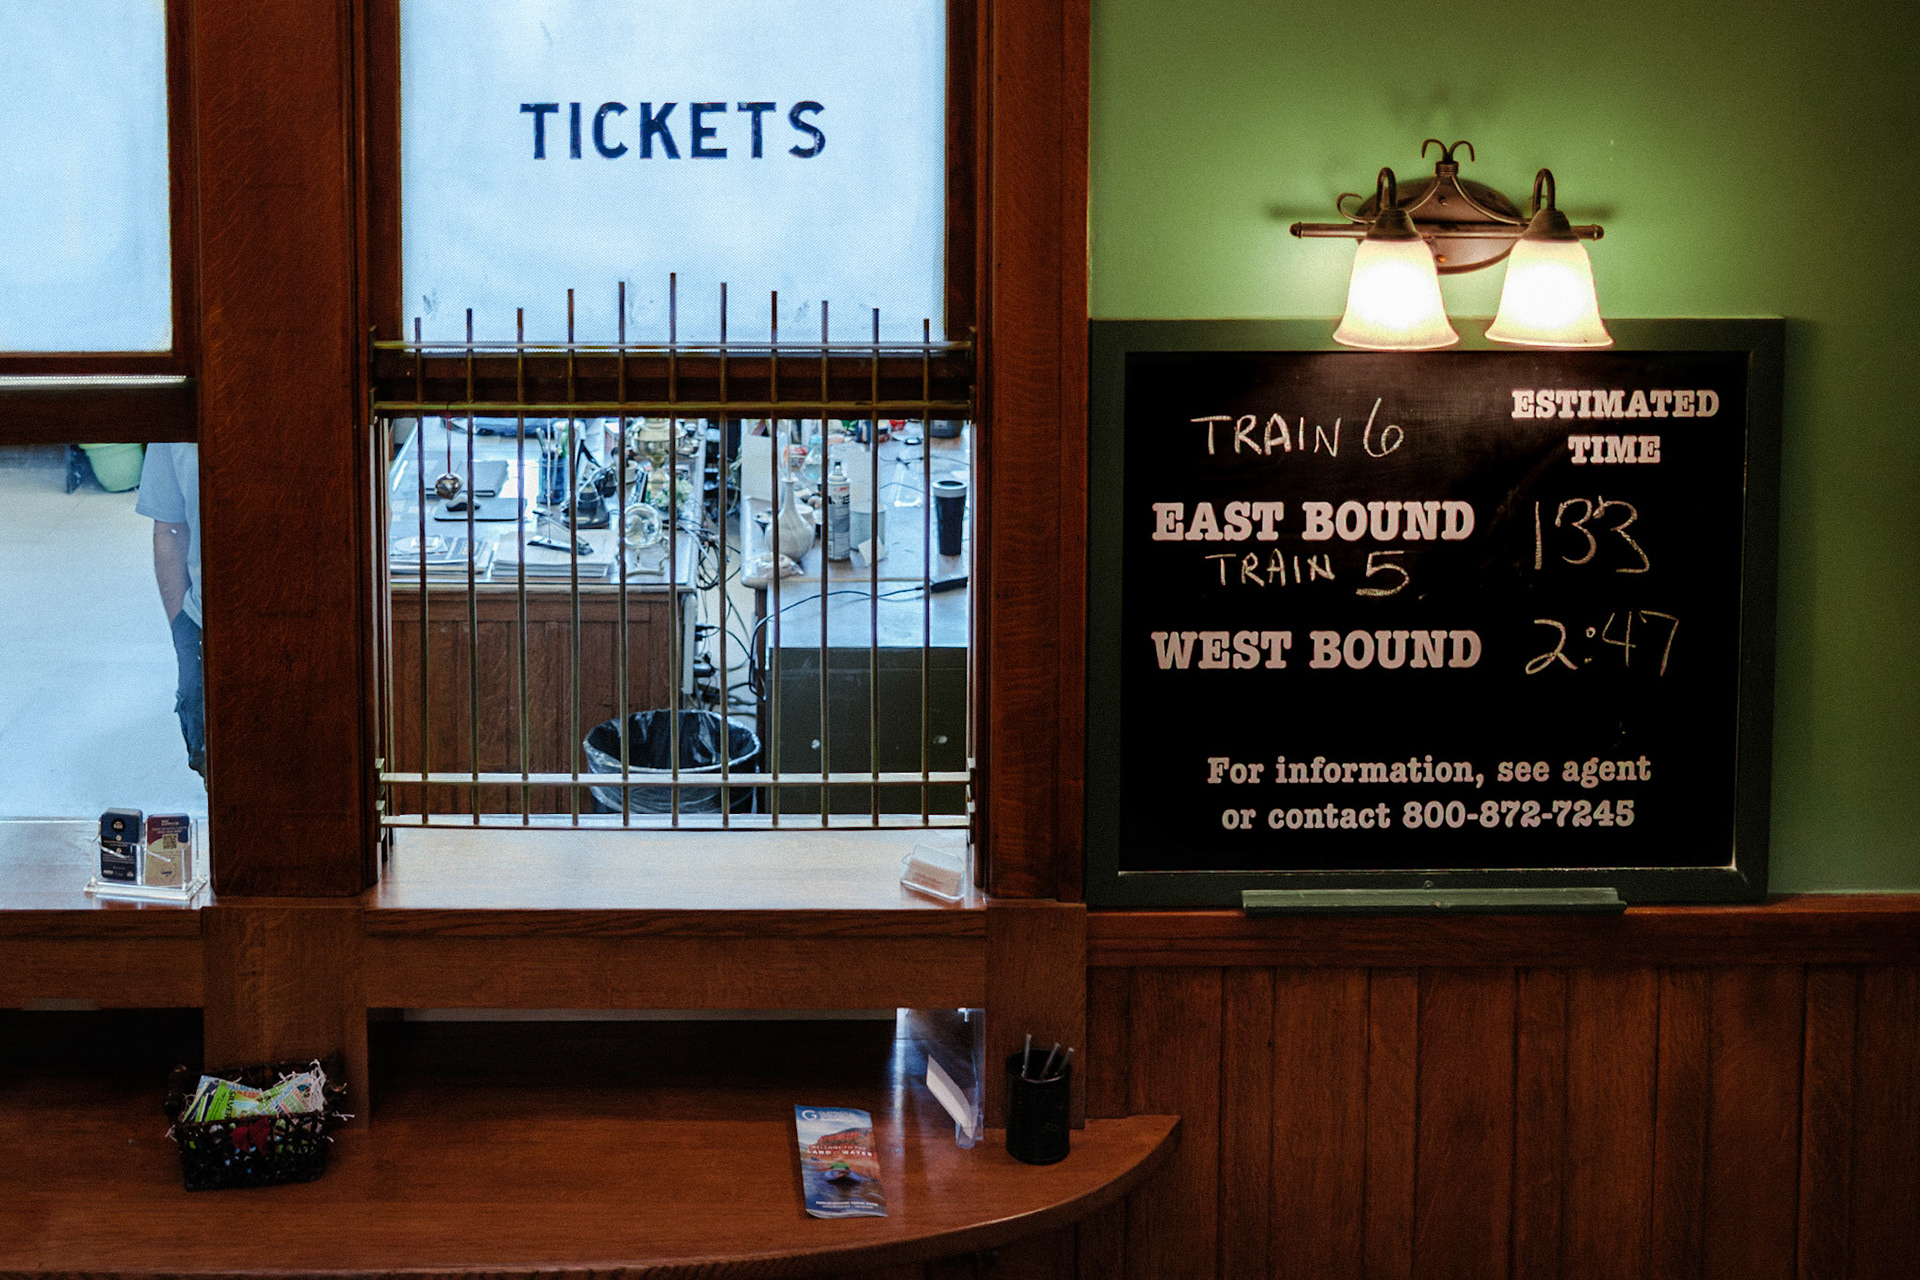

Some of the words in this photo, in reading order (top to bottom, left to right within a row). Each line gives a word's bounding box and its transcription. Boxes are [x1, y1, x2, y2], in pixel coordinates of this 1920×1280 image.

[521, 101, 826, 159] TICKETS
[1510, 388, 1720, 419] ESTIMATED
[1190, 412, 1341, 458] TRAIN
[1362, 397, 1405, 458] 6
[1567, 435, 1661, 464] TIME
[1151, 501, 1285, 542] EAST
[1301, 500, 1476, 542] BOUND
[1204, 547, 1336, 587] TRAIN
[1355, 550, 1410, 597] 5
[1150, 630, 1293, 670] WEST
[1309, 629, 1482, 670] BOUND
[1525, 609, 1680, 677] 2:47
[1207, 756, 1265, 785] For
[1275, 754, 1485, 789] information,
[1497, 761, 1550, 783] see
[1561, 755, 1651, 789] agent
[1221, 808, 1257, 830] or
[1267, 802, 1391, 830] contact
[1402, 799, 1636, 830] 800-872-7245
